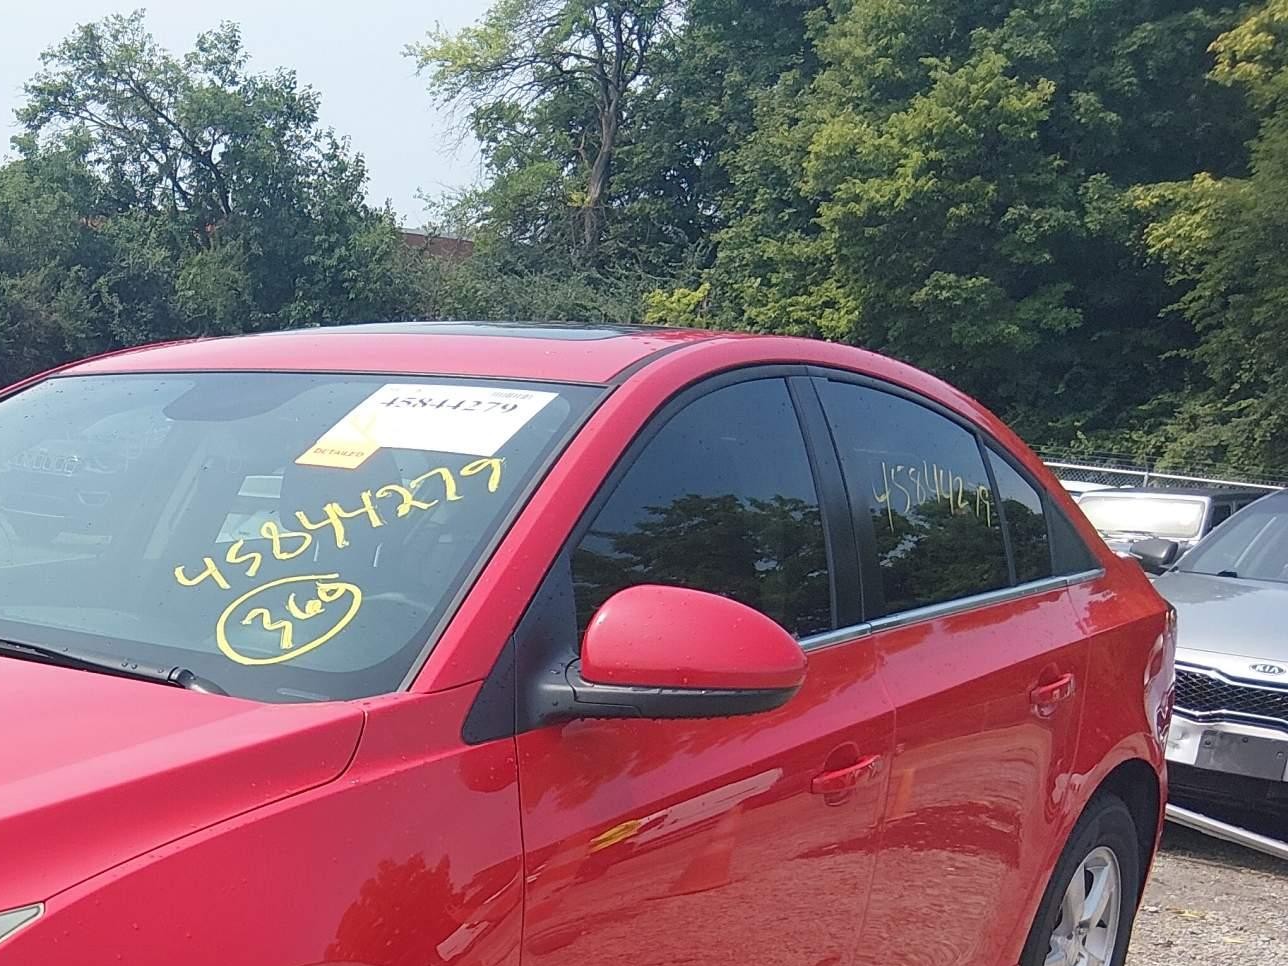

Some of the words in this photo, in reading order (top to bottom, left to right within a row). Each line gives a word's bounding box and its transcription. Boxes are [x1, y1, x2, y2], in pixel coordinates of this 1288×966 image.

[379, 395, 519, 414] 45844279
[313, 447, 365, 459] DETAILED
[174, 456, 506, 589] 45844279
[241, 578, 346, 650] 360
